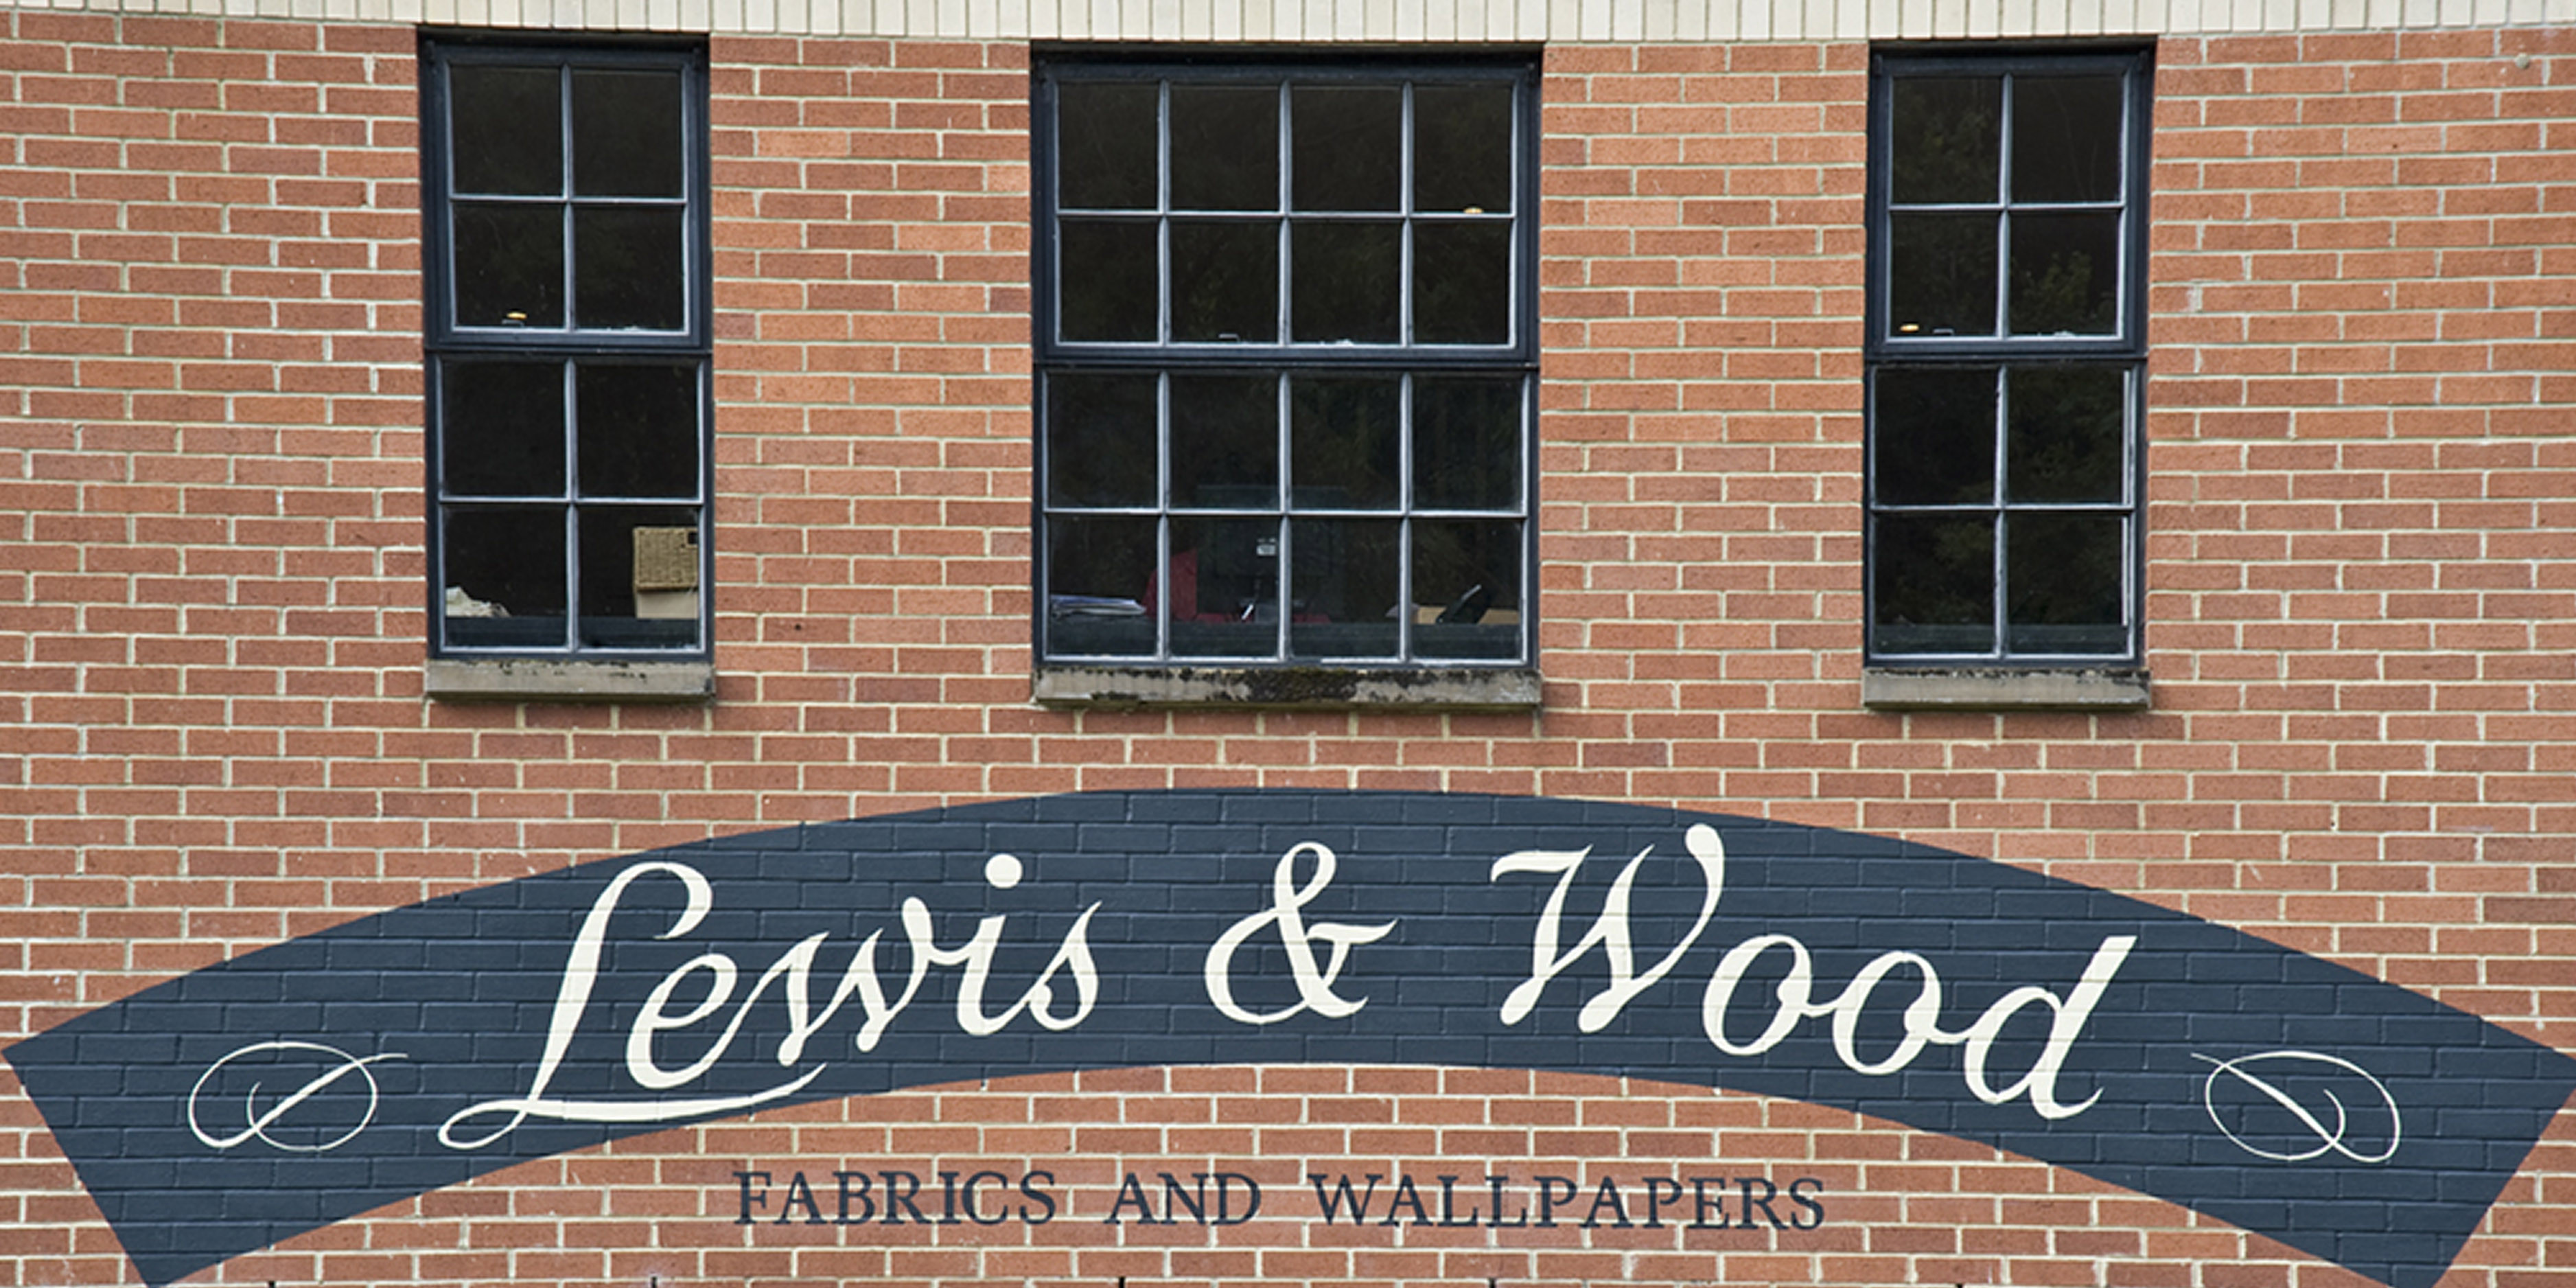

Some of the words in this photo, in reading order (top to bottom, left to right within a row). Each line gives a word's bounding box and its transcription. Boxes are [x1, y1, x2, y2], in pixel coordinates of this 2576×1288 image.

[439, 853, 1102, 1149] Lewis
[1205, 842, 1397, 1024] &
[1491, 824, 2137, 1119] Wood
[732, 1170, 1057, 1226] FABRICS
[1102, 1173, 1262, 1227] AND
[1306, 1173, 1826, 1232] WALLPAPERS
